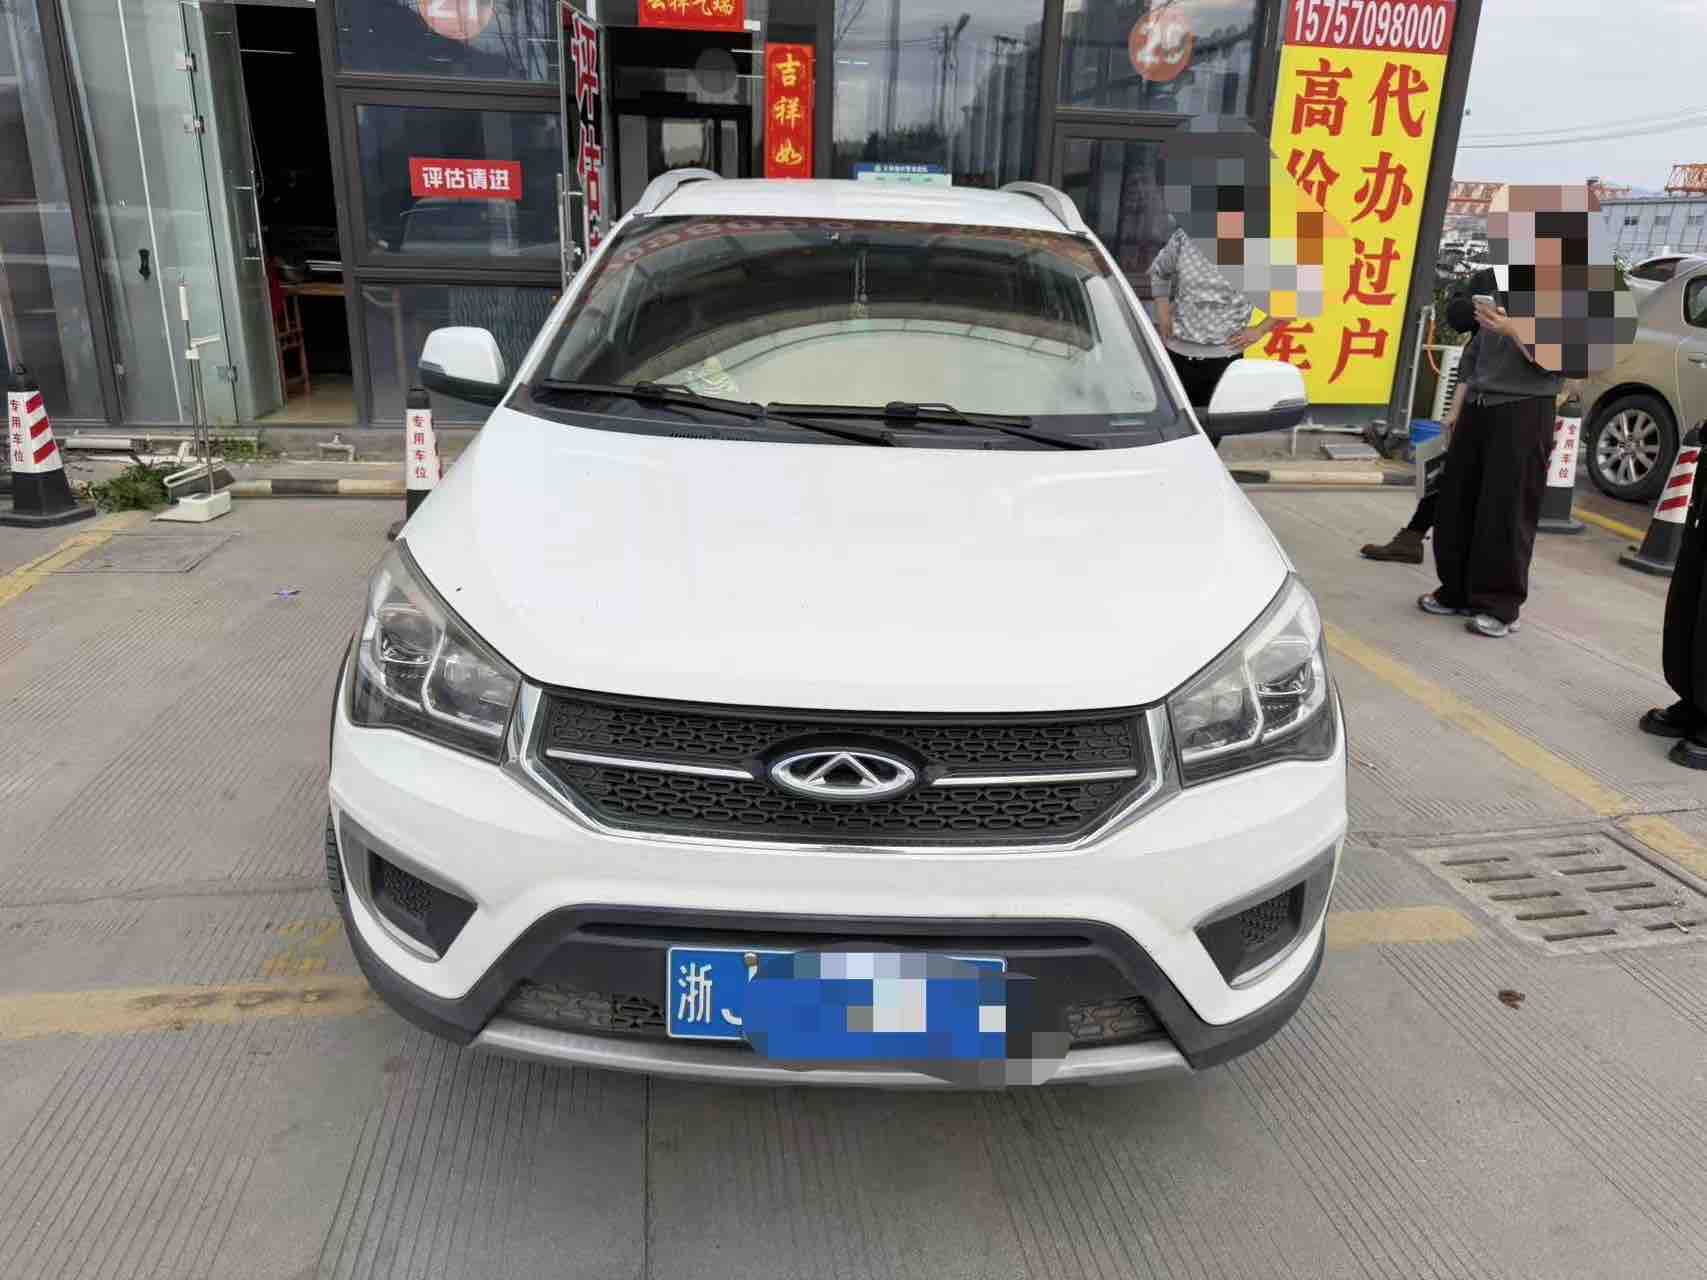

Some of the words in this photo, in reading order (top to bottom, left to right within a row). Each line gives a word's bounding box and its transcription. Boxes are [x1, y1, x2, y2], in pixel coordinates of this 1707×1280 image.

[1295, 0, 1446, 49] 15757098000
[773, 52, 803, 181] 吉祥如
[422, 166, 511, 191] 评估请进
[1264, 58, 1352, 370] 高价车
[1328, 62, 1429, 384] 代办过户
[10, 398, 25, 464] 专用车位
[412, 414, 427, 479] 专用车位
